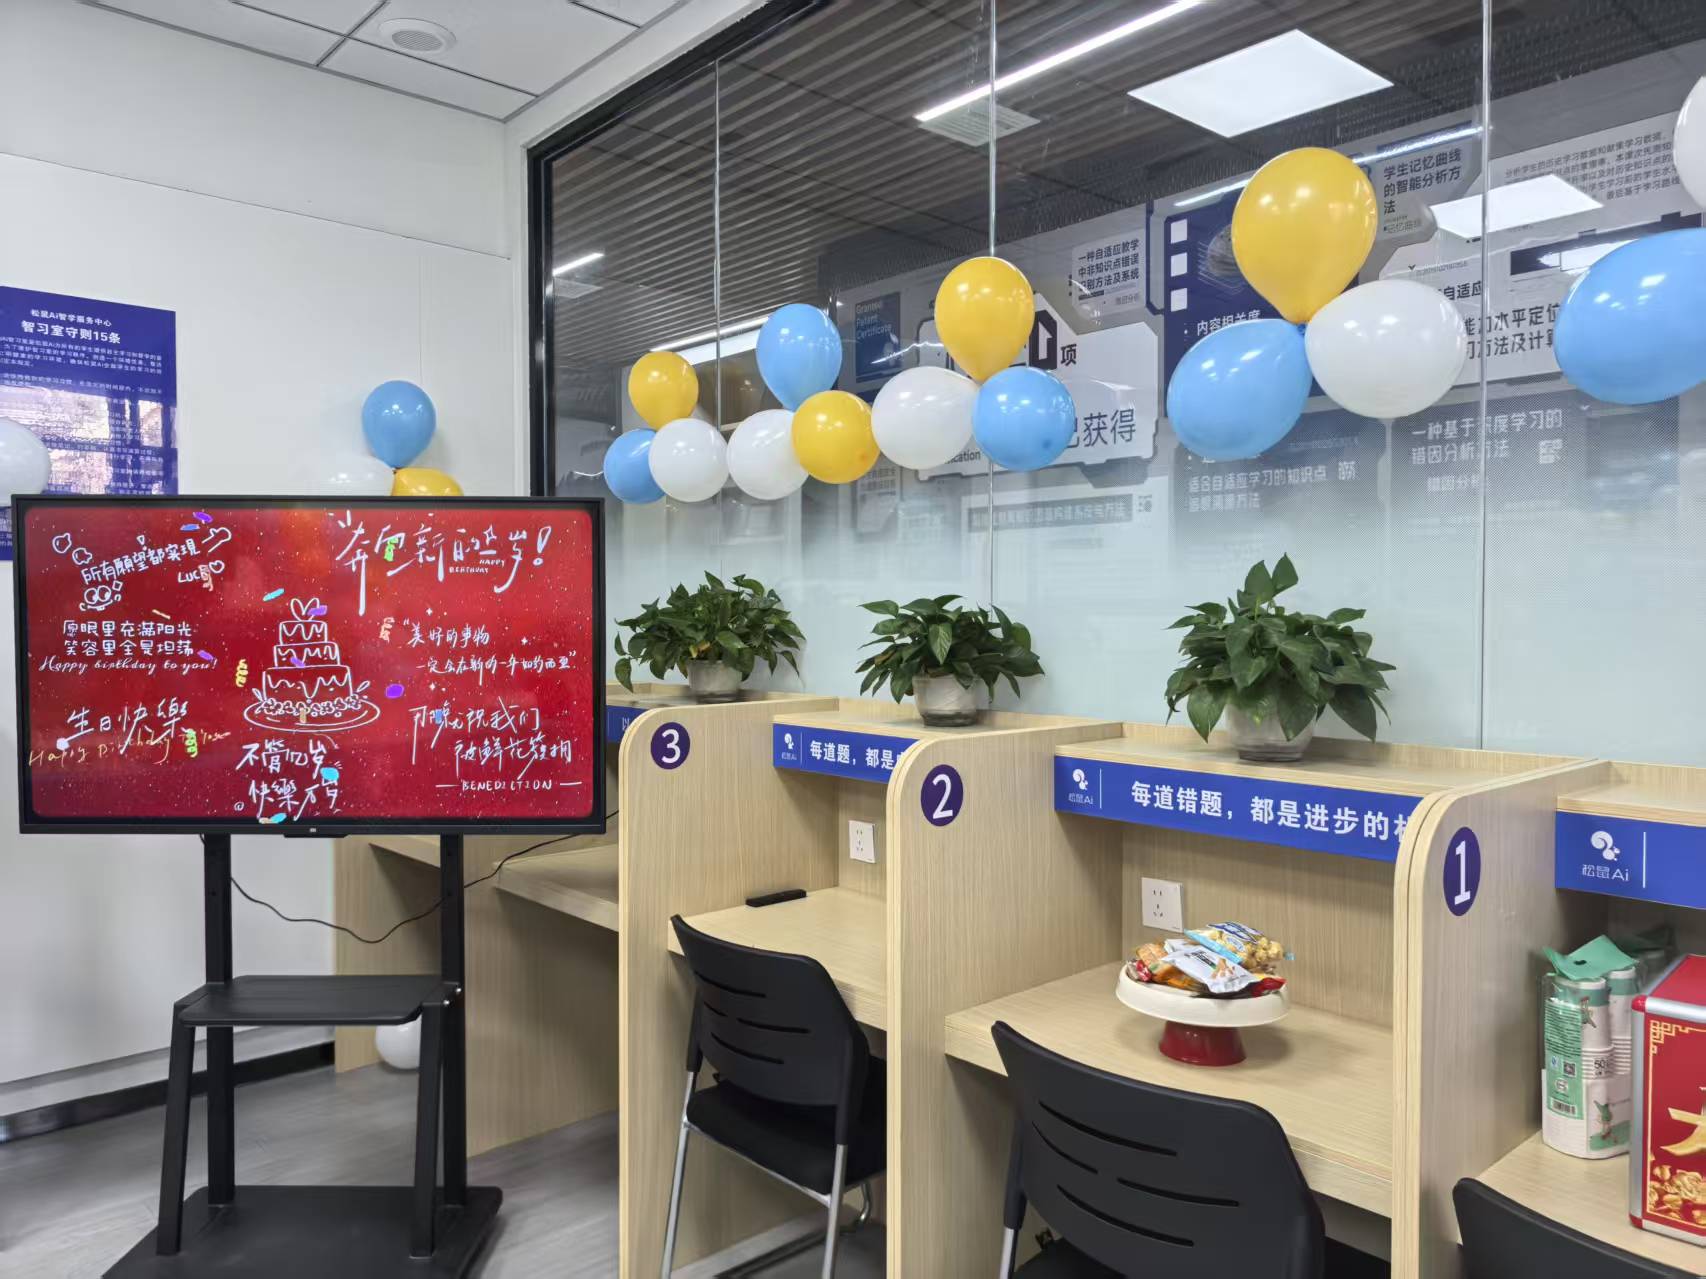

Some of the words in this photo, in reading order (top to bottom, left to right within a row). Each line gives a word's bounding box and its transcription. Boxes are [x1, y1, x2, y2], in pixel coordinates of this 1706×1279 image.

[1383, 148, 1462, 181] 学生记忆曲线
[1383, 166, 1462, 198] 的智能分析方
[1383, 200, 1396, 215] 法
[1078, 238, 1139, 262] 一种自适应教学
[1440, 280, 1482, 301] 自适应
[21, 320, 121, 344] 智习室守则15条
[63, 620, 193, 638] 愿眼里充满阳光
[64, 639, 194, 657] 笑容里全是坦荡
[38, 655, 88, 675] Happy
[94, 657, 156, 675] birthday
[163, 660, 178, 670] to
[661, 728, 681, 764] 3
[932, 773, 954, 819] 2
[1454, 840, 1471, 905] 1
[1582, 863, 1629, 882] 松鼠Ai
